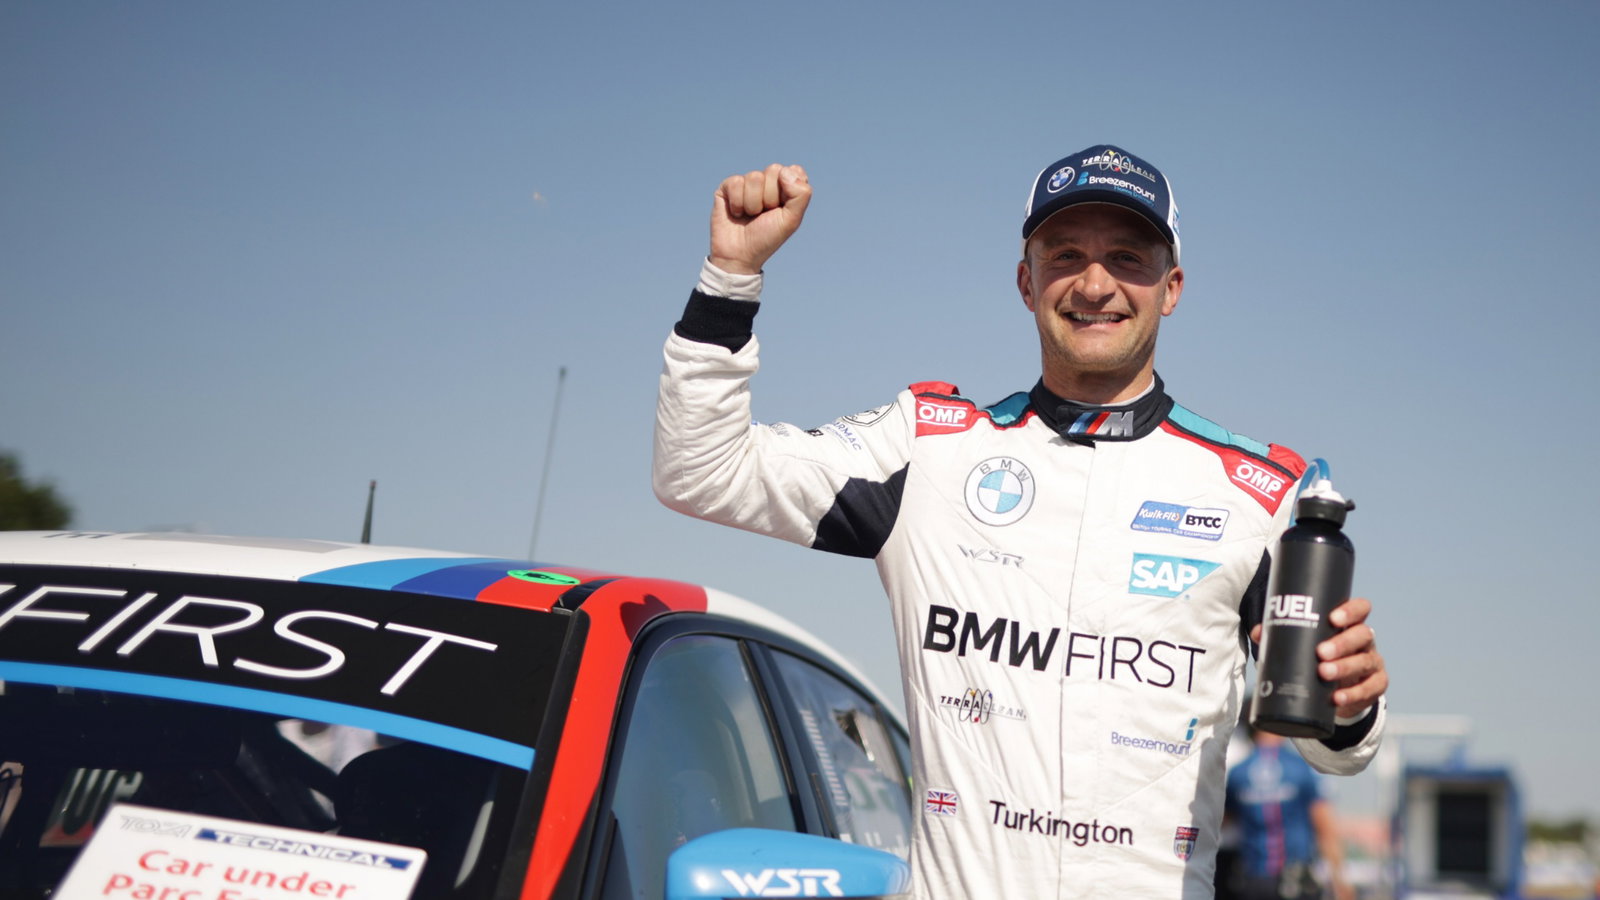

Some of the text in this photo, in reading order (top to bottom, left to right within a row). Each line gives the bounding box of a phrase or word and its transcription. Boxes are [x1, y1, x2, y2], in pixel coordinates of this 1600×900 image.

[1089, 176, 1156, 201] Breezemount
[918, 405, 967, 424] OMP
[979, 459, 1030, 482] BMW
[1236, 464, 1282, 493] OMP
[1185, 514, 1222, 529] BTCC
[1131, 559, 1200, 593] SAP
[1267, 594, 1320, 621] FUEL
[0, 585, 498, 696] FIRST
[923, 604, 1206, 694] BMW FIRST
[1111, 732, 1191, 757] Breezemount
[989, 799, 1134, 847] Turkington
[214, 831, 394, 869] TECHNICAL
[137, 849, 356, 900] Car under
[720, 868, 844, 897] WSR
